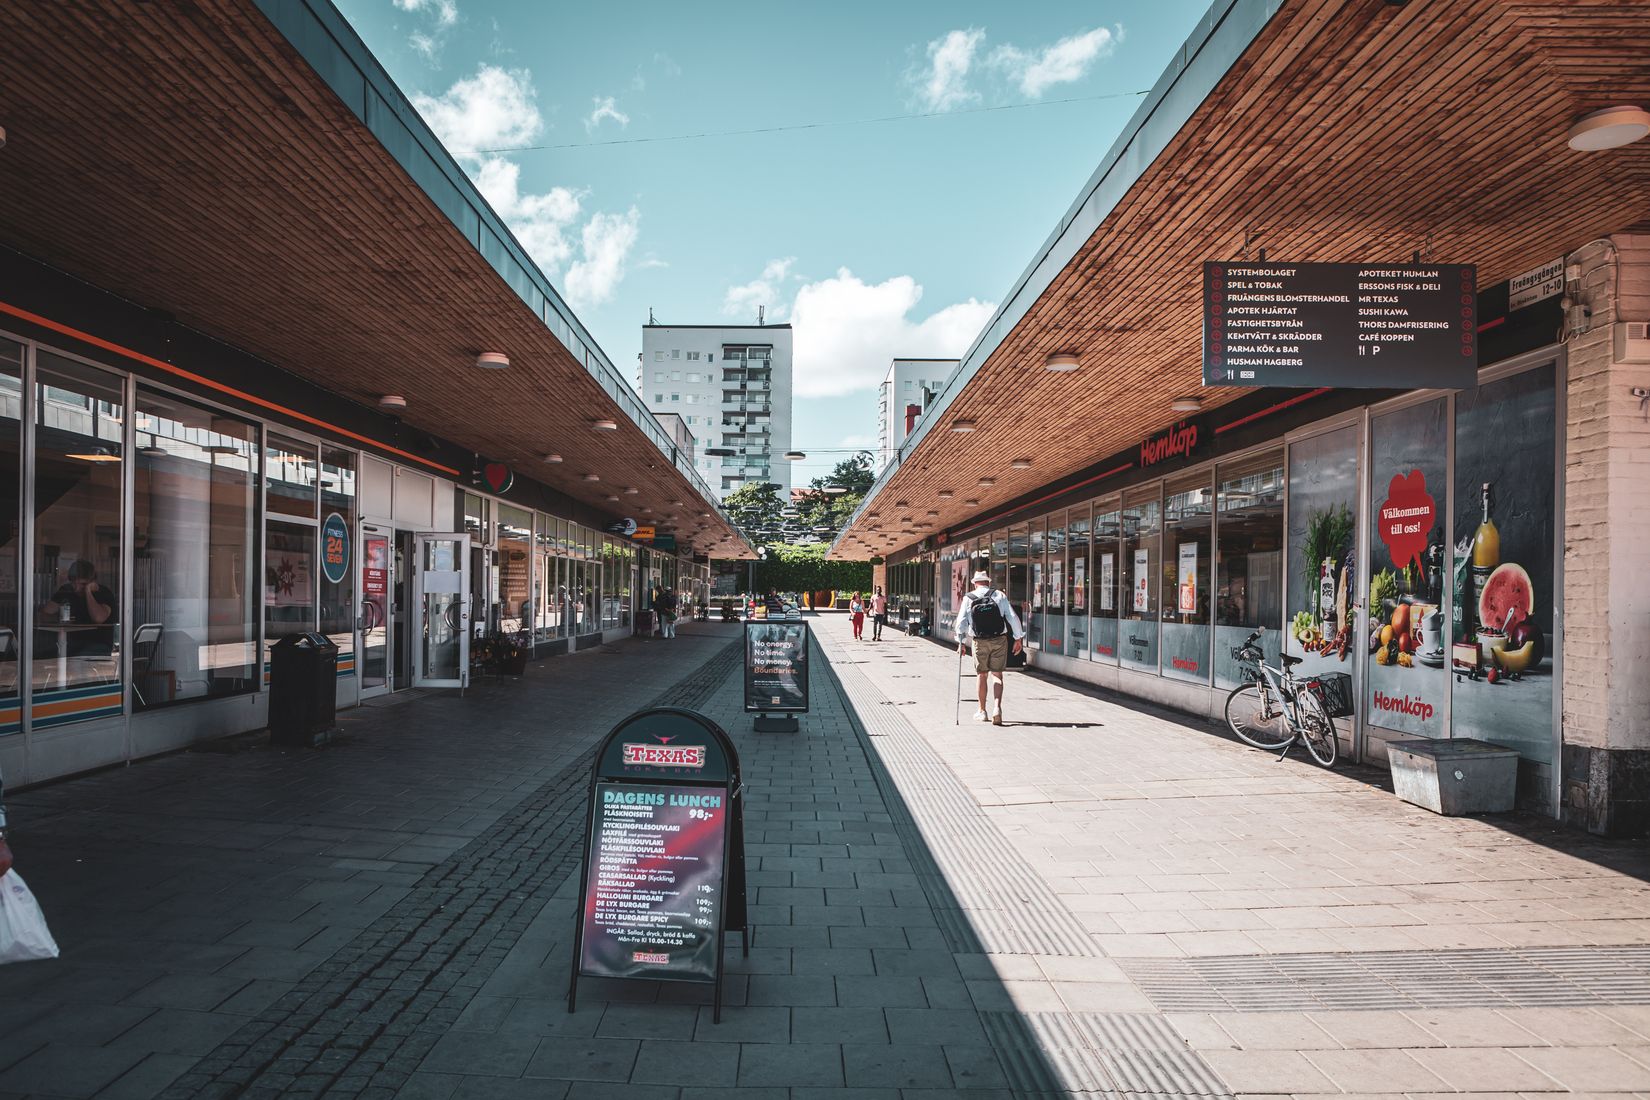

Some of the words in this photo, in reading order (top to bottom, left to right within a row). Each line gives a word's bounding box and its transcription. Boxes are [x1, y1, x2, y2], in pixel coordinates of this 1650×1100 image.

[1512, 264, 1562, 290] Fruängsgången
[1542, 279, 1562, 296] 12-10
[1228, 293, 1274, 302] FRUÄNGENS
[1276, 294, 1350, 302] BLOMSTERHANDEL
[1262, 306, 1298, 314] HJÄRTAT
[1228, 319, 1303, 327] FASTIGHETSBYRÅN
[1228, 332, 1270, 340] KEMTVÄTT
[1278, 332, 1322, 340] SKRÄDDER
[1358, 332, 1380, 341] CAFÉ
[1257, 344, 1274, 352] KÖK
[1372, 346, 1380, 355] P
[1141, 421, 1197, 467] Hemköp
[1383, 506, 1430, 519] Välkommen
[1391, 524, 1402, 534] till
[1404, 522, 1420, 534] oss!
[327, 536, 342, 554] 24
[1374, 690, 1433, 721] Hemköp
[630, 747, 698, 764] TEXAS
[604, 792, 665, 806] DAGENS
[669, 794, 721, 808] LUNCH
[604, 810, 654, 818] FLÄSKNOISETTE
[603, 822, 680, 832] KYCKLINGFILÉSOUVLAKI
[601, 844, 666, 854] FLÄSKFILÉSOUVLAKI
[600, 856, 638, 864] RÖDSPÄTTA
[598, 872, 646, 880] CEASARSALLAD
[648, 875, 676, 883] (Kyckling)
[598, 879, 636, 888] RÄKSALLAD
[632, 894, 664, 902] BURGARE
